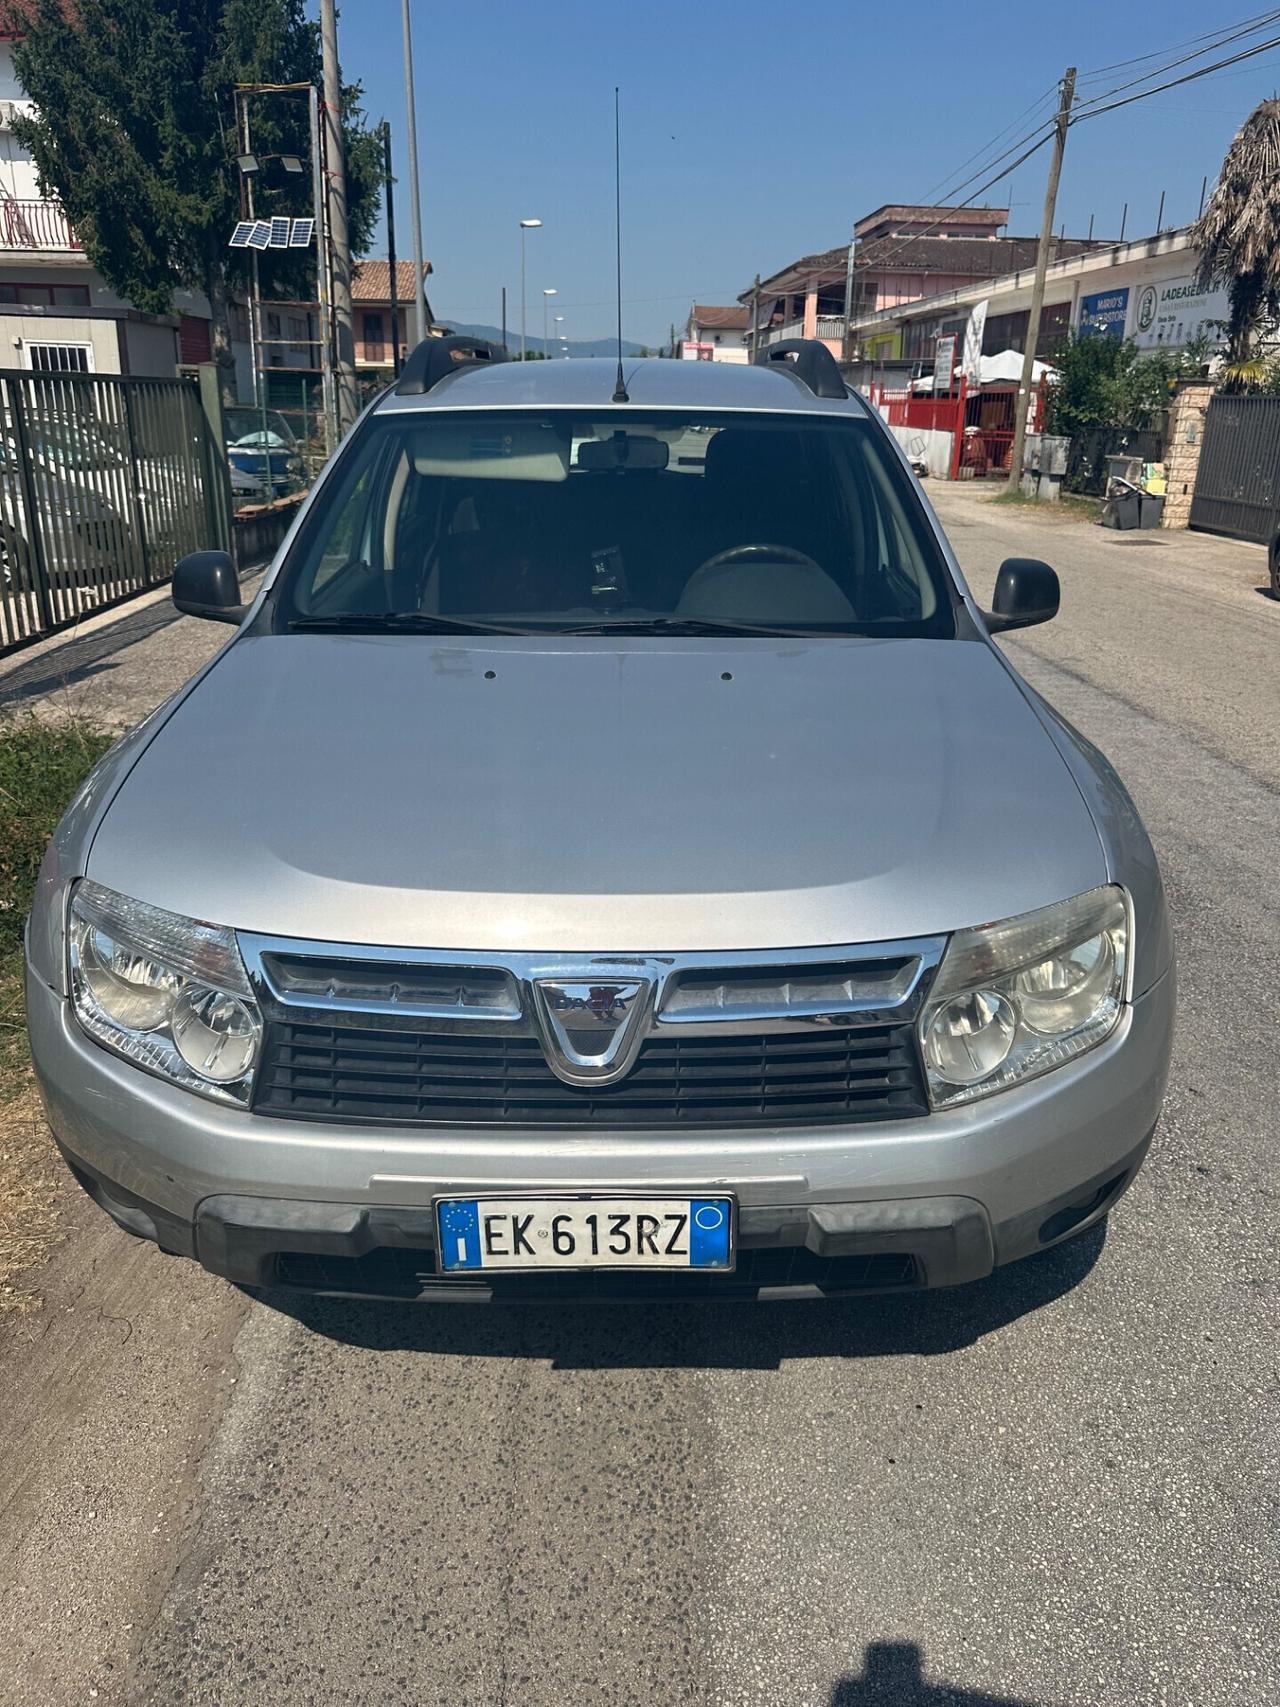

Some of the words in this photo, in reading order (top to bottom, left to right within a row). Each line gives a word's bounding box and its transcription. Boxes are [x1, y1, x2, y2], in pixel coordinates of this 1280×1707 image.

[1097, 296, 1123, 311] MARIO'S
[554, 998, 627, 1011] DACIA
[484, 1214, 536, 1256] EK
